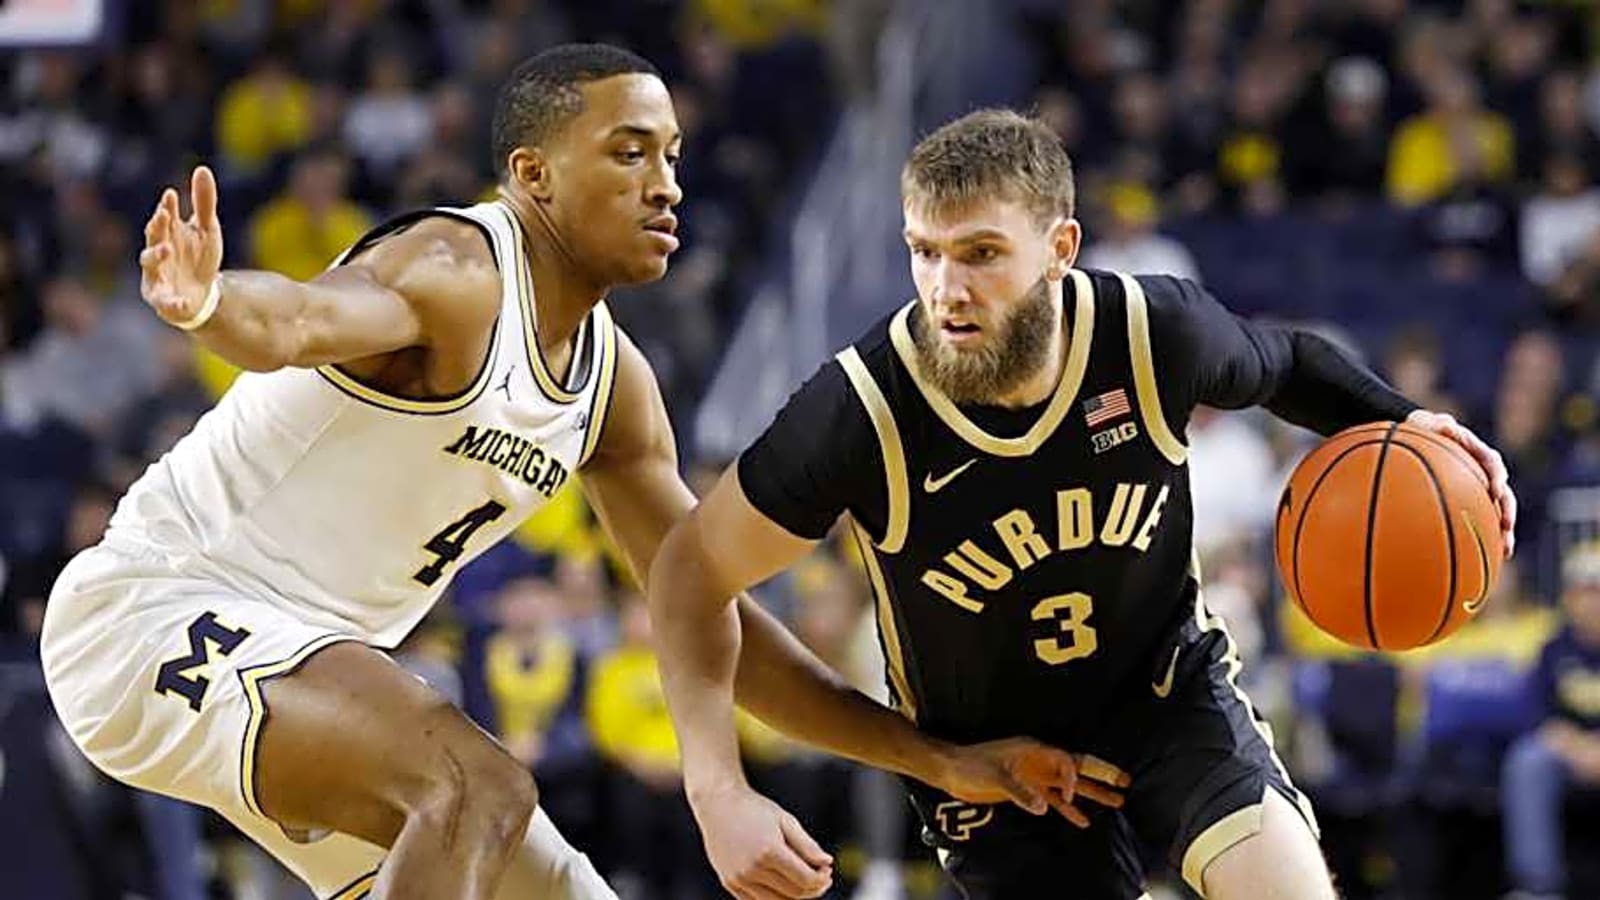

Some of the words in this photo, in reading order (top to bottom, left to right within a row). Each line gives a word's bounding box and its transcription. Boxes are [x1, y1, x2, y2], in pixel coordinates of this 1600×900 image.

[443, 426, 568, 498] MICHIGA
[413, 500, 506, 587] 4
[920, 483, 1169, 613] PURDUE
[154, 610, 252, 713] M
[1031, 592, 1097, 665] 3
